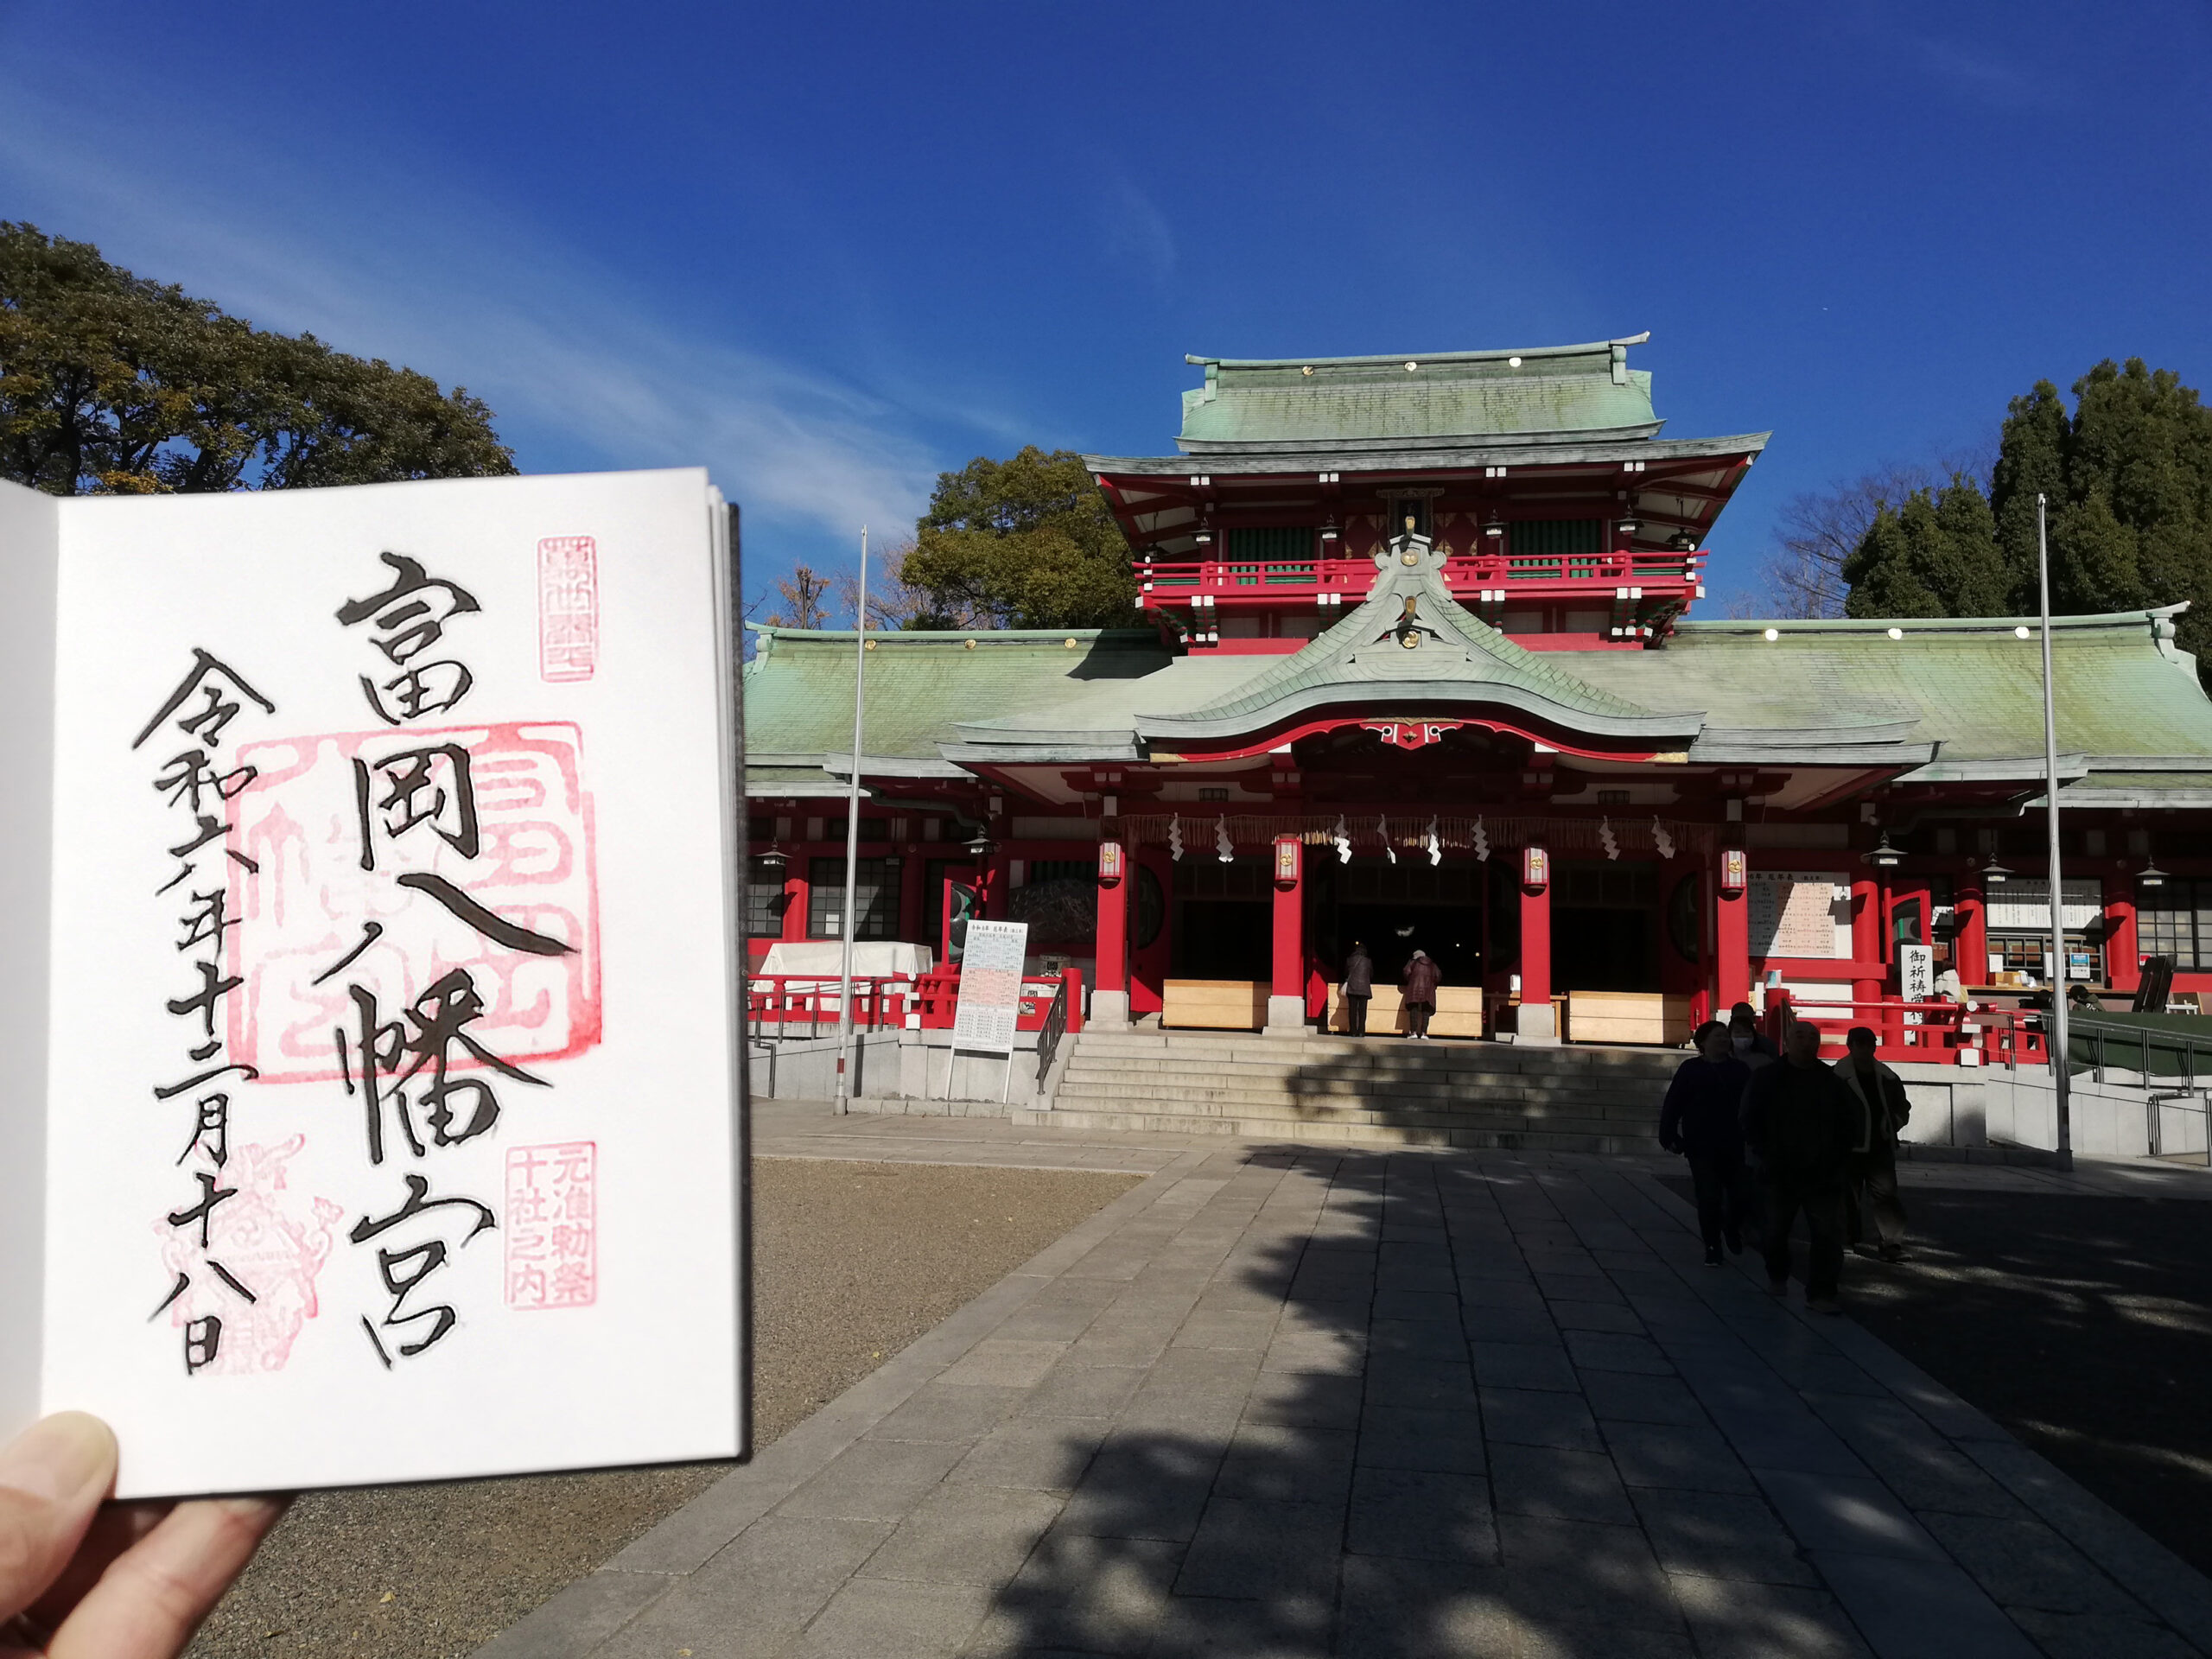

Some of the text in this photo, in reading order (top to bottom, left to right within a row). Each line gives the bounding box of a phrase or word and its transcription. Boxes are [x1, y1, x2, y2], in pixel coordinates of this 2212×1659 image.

[133, 648, 276, 1376] 令和六年十二月十八日
[314, 551, 578, 1370] 富岡八幡宮
[510, 1152, 548, 1304] 十社之内
